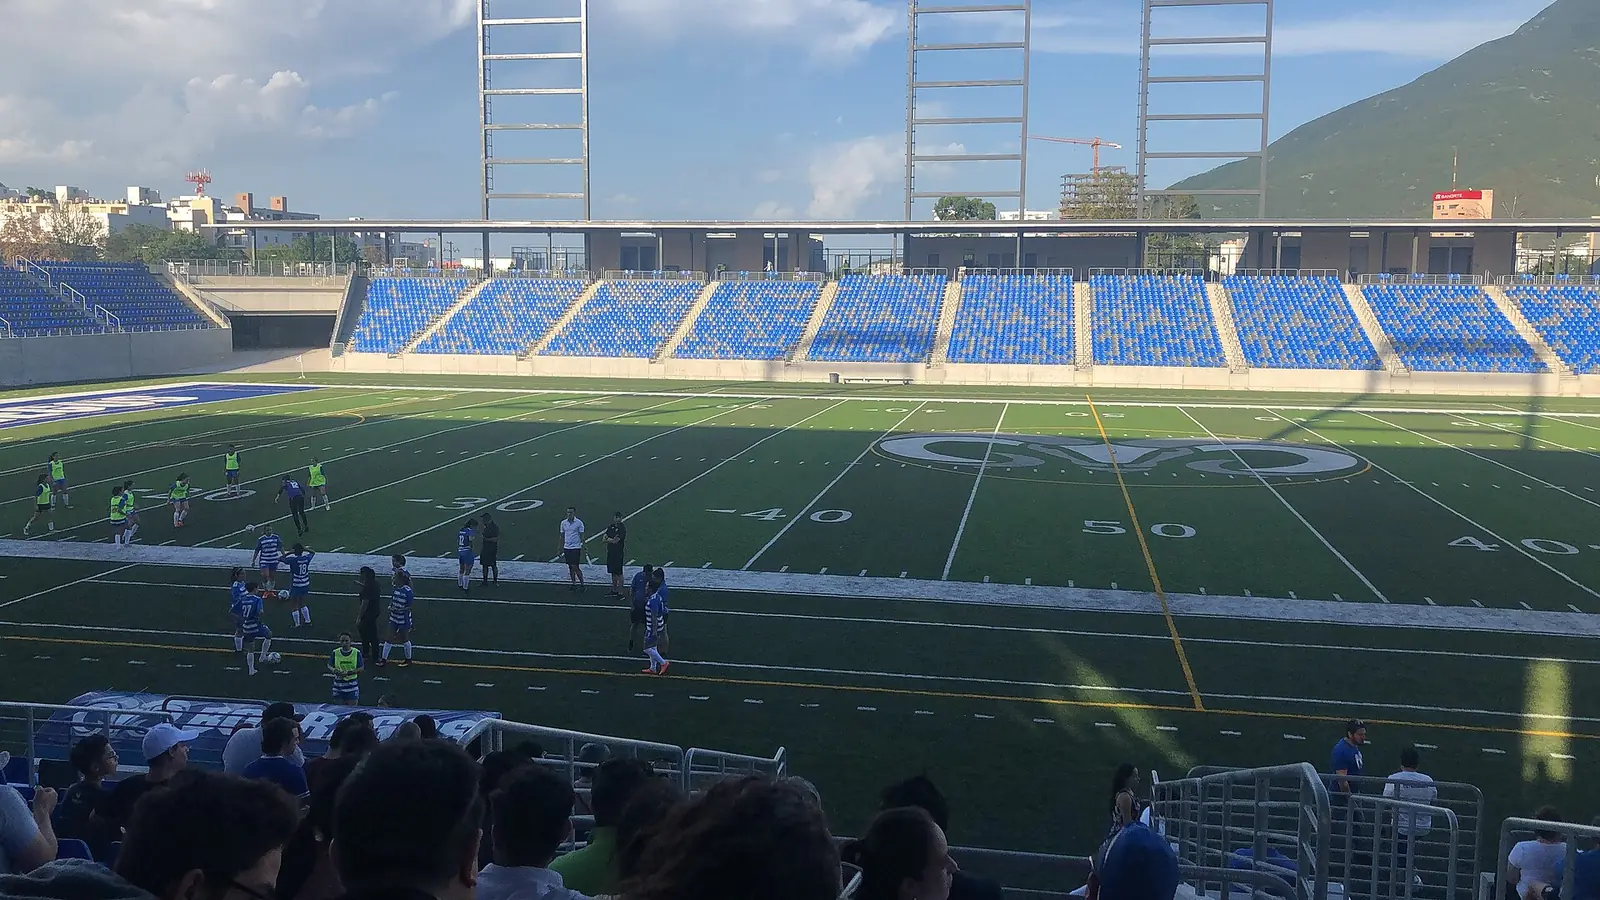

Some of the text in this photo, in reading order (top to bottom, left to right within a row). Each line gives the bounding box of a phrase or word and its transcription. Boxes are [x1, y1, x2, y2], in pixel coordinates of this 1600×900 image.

[436, 497, 543, 511] 30
[740, 508, 852, 523] 40
[1082, 520, 1196, 538] 50
[1448, 536, 1579, 555] 40
[298, 563, 308, 575] 18
[242, 604, 252, 618] 27
